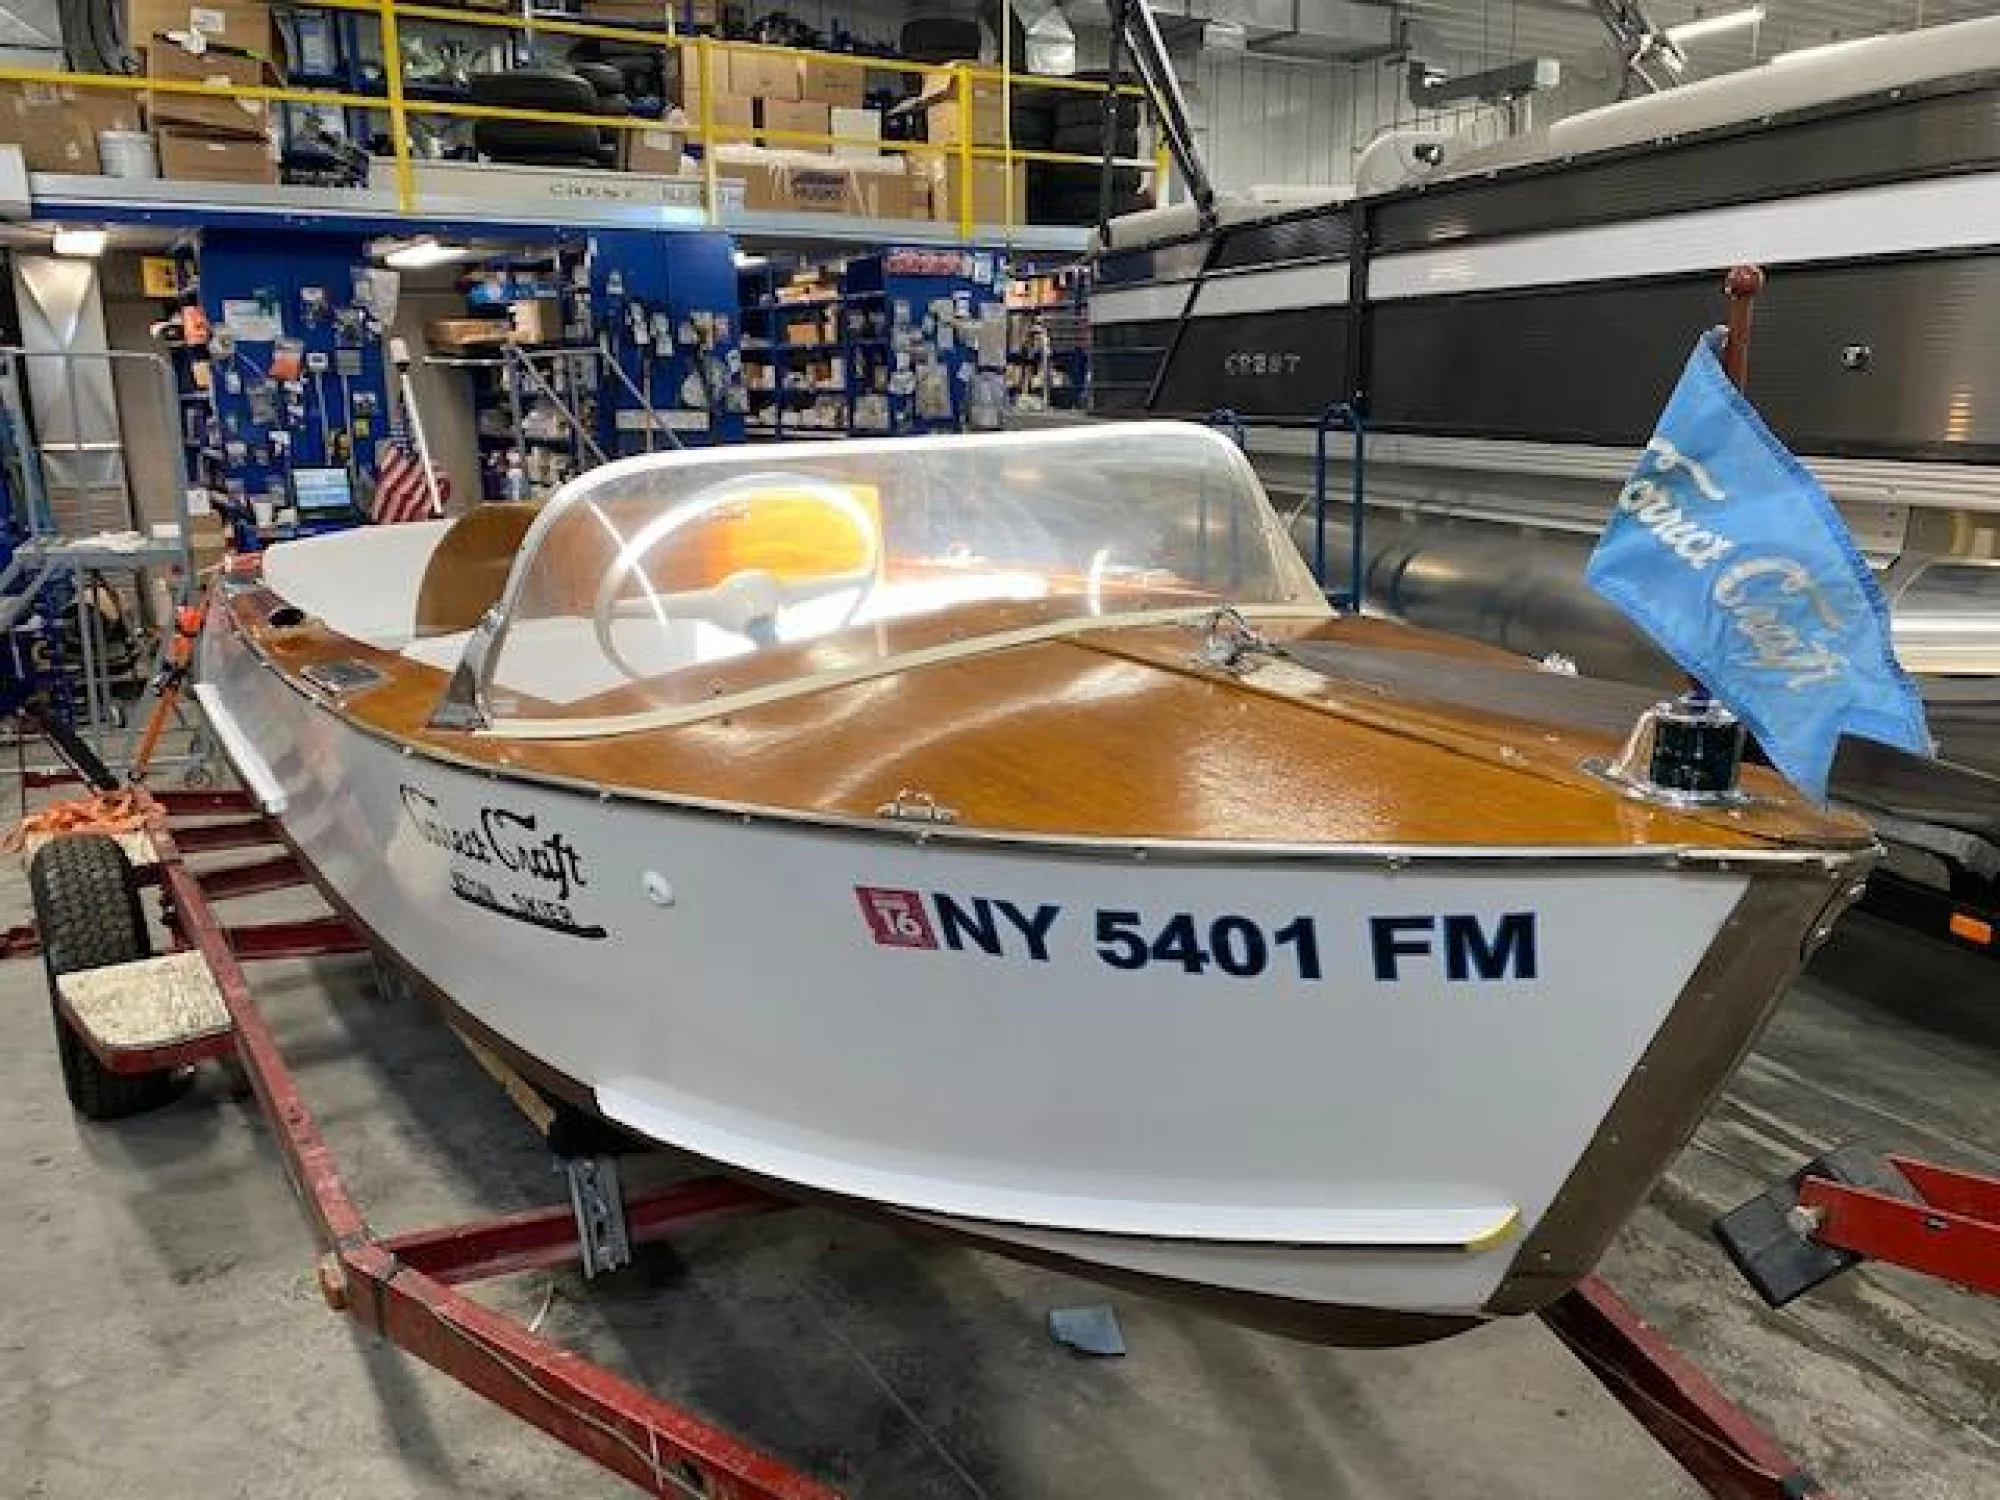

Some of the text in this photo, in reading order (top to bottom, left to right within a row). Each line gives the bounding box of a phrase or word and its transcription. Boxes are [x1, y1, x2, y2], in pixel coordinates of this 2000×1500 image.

[481, 806, 587, 900] Craft
[931, 891, 1540, 982] NY 5401 FM
